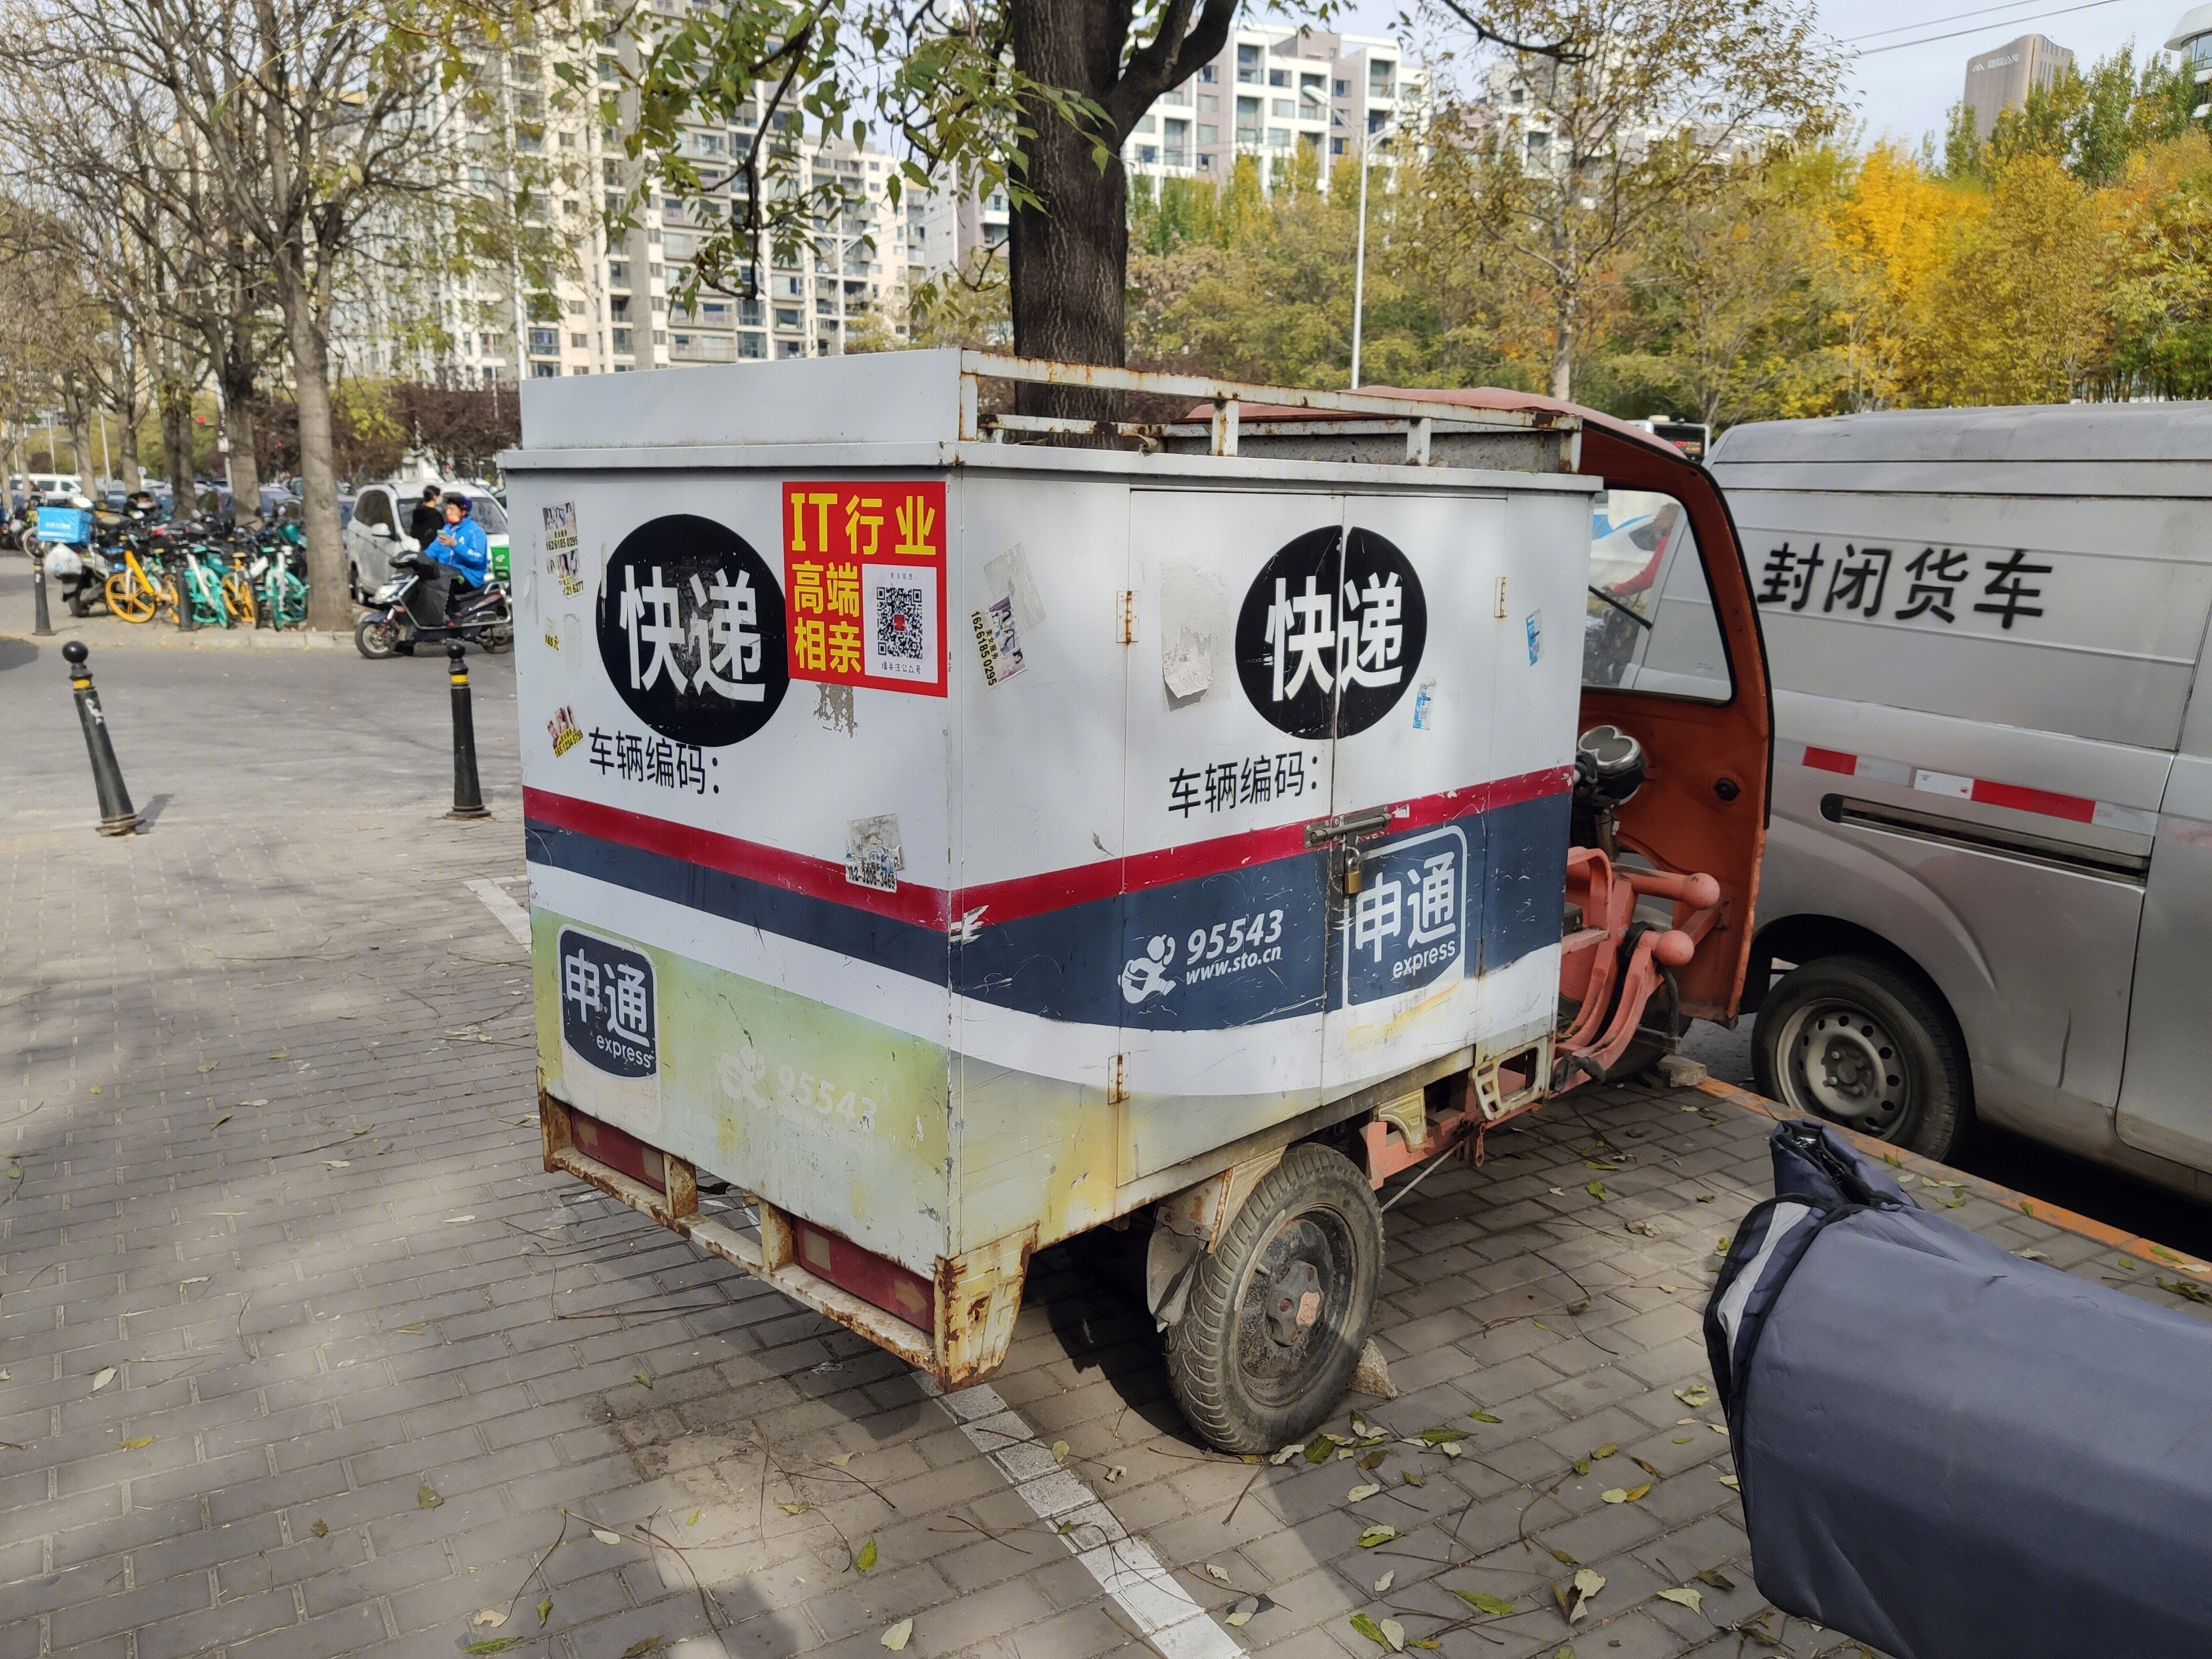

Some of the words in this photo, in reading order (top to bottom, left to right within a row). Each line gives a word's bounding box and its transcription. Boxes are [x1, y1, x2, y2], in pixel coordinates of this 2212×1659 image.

[790, 492, 937, 556] IT行业
[792, 560, 860, 617] 高端
[1757, 542, 2053, 629] 封闭货车
[619, 564, 766, 702] 快递
[794, 617, 862, 674] 相亲
[985, 629, 998, 659] 美女服务
[1265, 571, 1403, 702] 快递
[881, 662, 921, 675] 请关注公众号
[1355, 851, 1456, 963] 申通
[1186, 945, 1281, 985] www.sto.cn
[1187, 909, 1284, 964] 95543
[1392, 940, 1456, 979] express
[565, 948, 650, 1047] 申通
[596, 1033, 654, 1068] express
[778, 1065, 878, 1133] 95543
